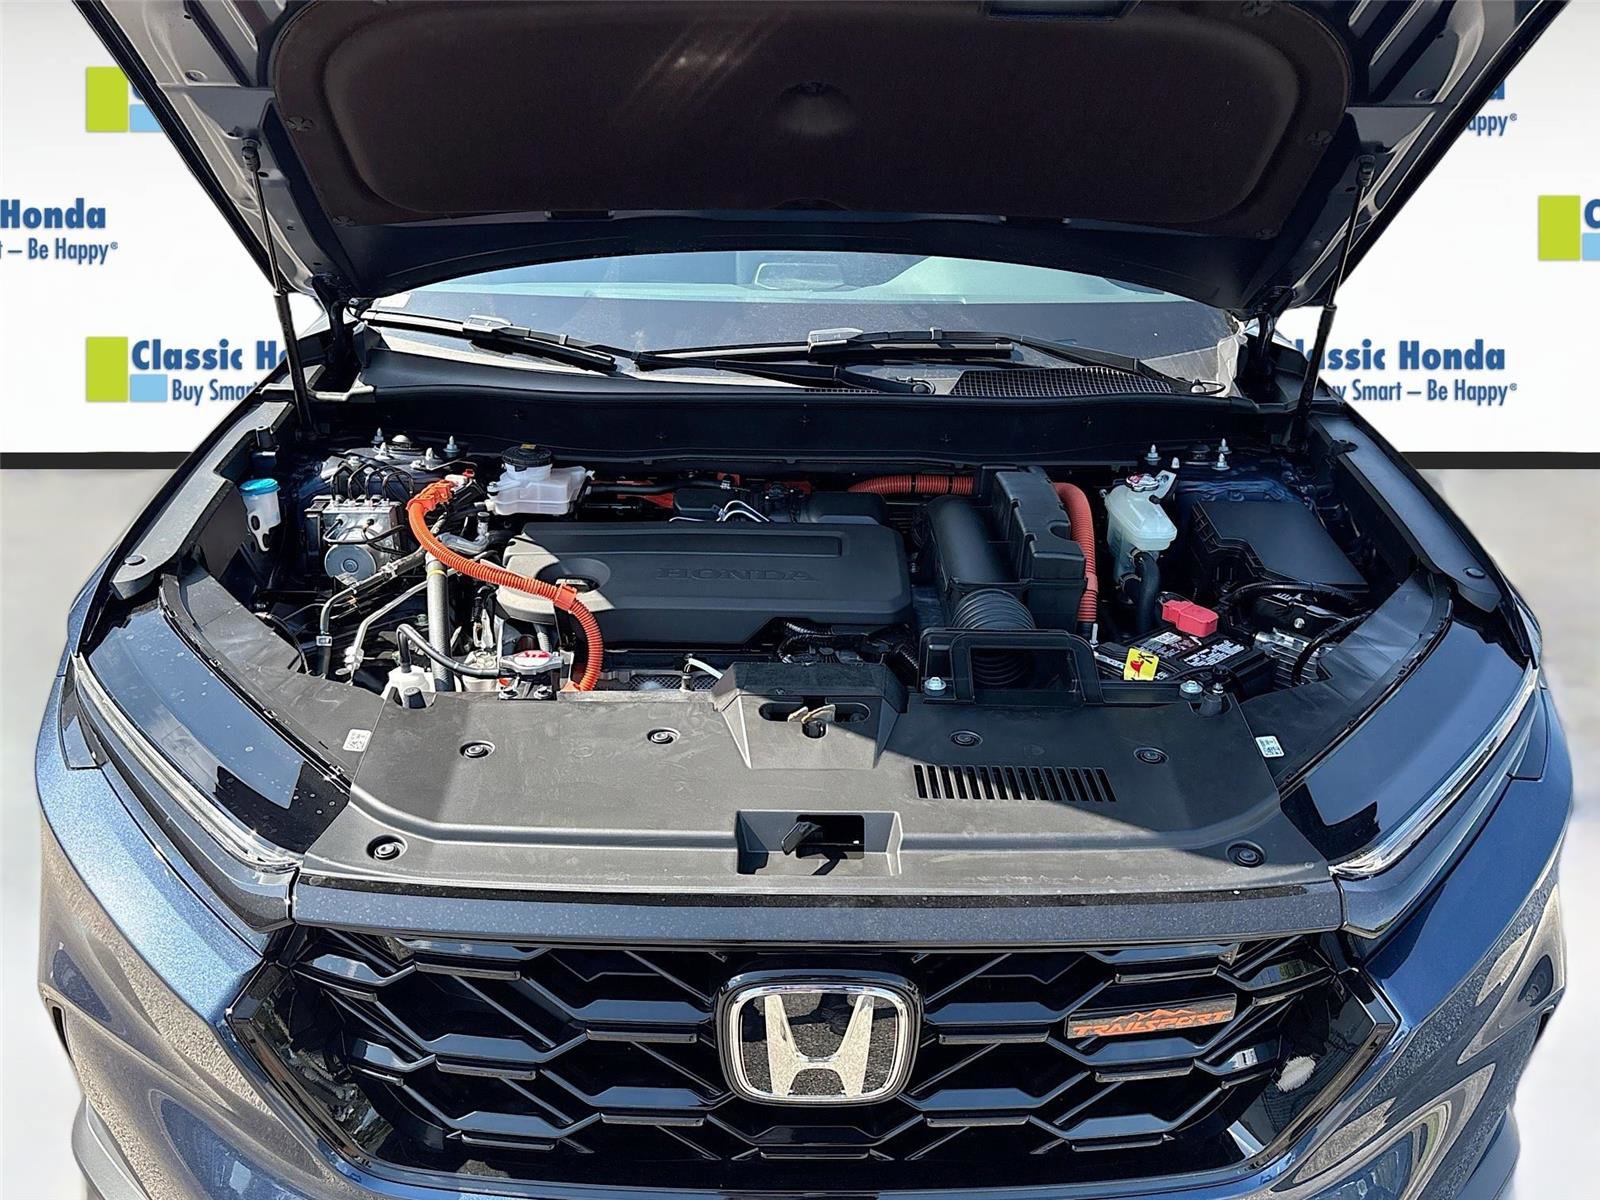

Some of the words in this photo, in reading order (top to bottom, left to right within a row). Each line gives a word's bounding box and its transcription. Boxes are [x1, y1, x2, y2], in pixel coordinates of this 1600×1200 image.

[0, 197, 106, 229] Honda
[28, 237, 49, 260] Be
[131, 338, 243, 371] Classic
[1295, 338, 1386, 371] ssic
[1399, 338, 1506, 371] Honda
[172, 378, 204, 406] Buy
[209, 378, 257, 401] Smar
[1352, 378, 1402, 401] Smart
[1427, 378, 1449, 401] Be
[656, 567, 821, 583] HONDA
[1072, 1009, 1233, 1037] TRAILSPORT
